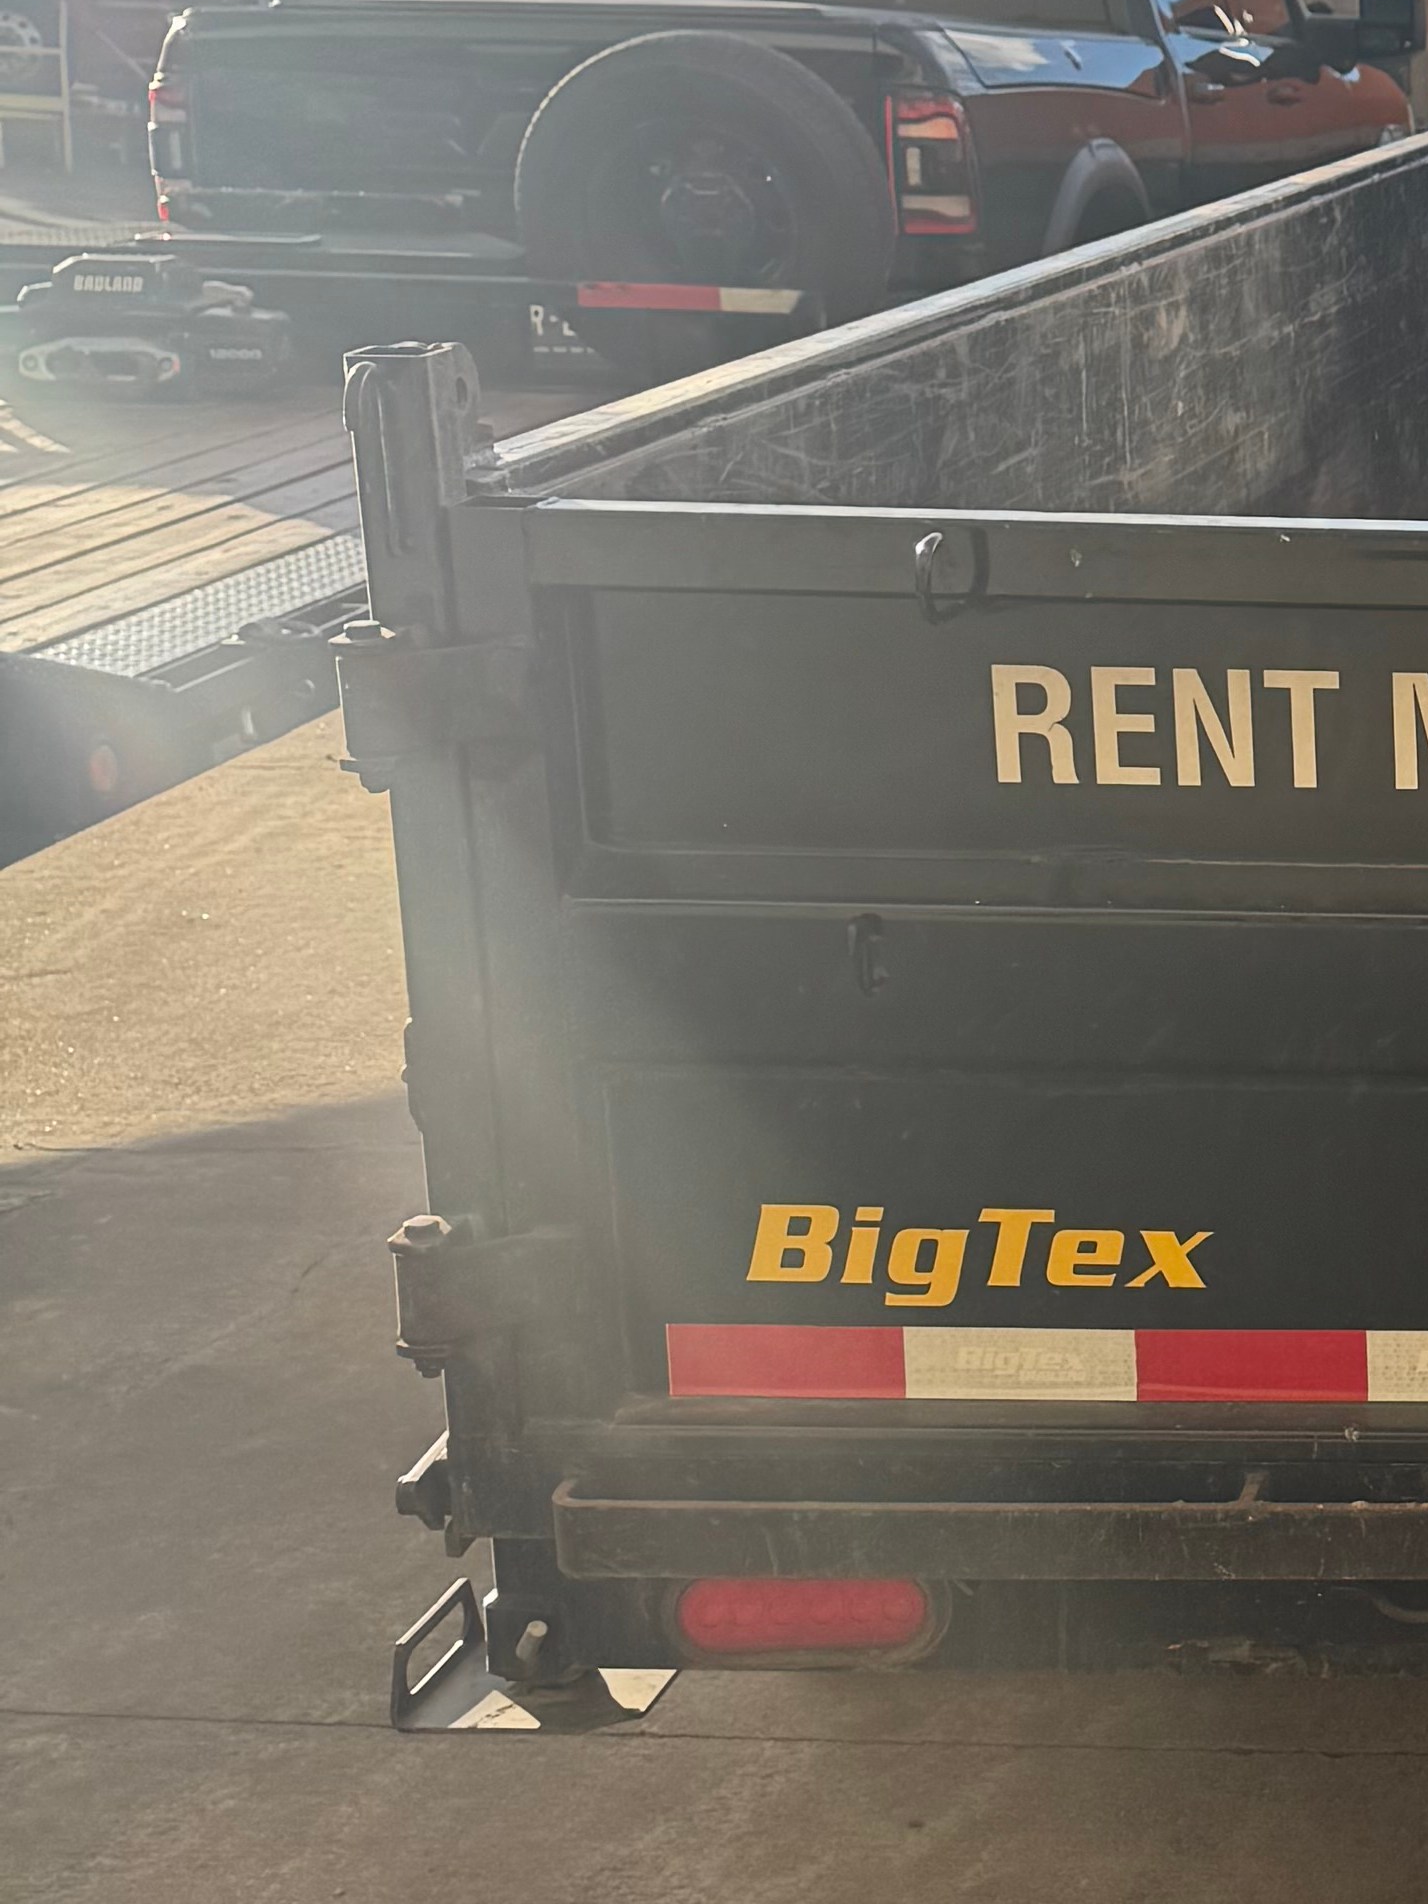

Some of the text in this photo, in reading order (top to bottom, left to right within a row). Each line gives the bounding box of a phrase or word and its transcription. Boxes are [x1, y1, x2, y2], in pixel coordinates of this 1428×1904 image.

[990, 663, 1341, 789] RENT
[746, 1203, 1215, 1307] BigTex
[956, 1346, 1087, 1376] BigTex
